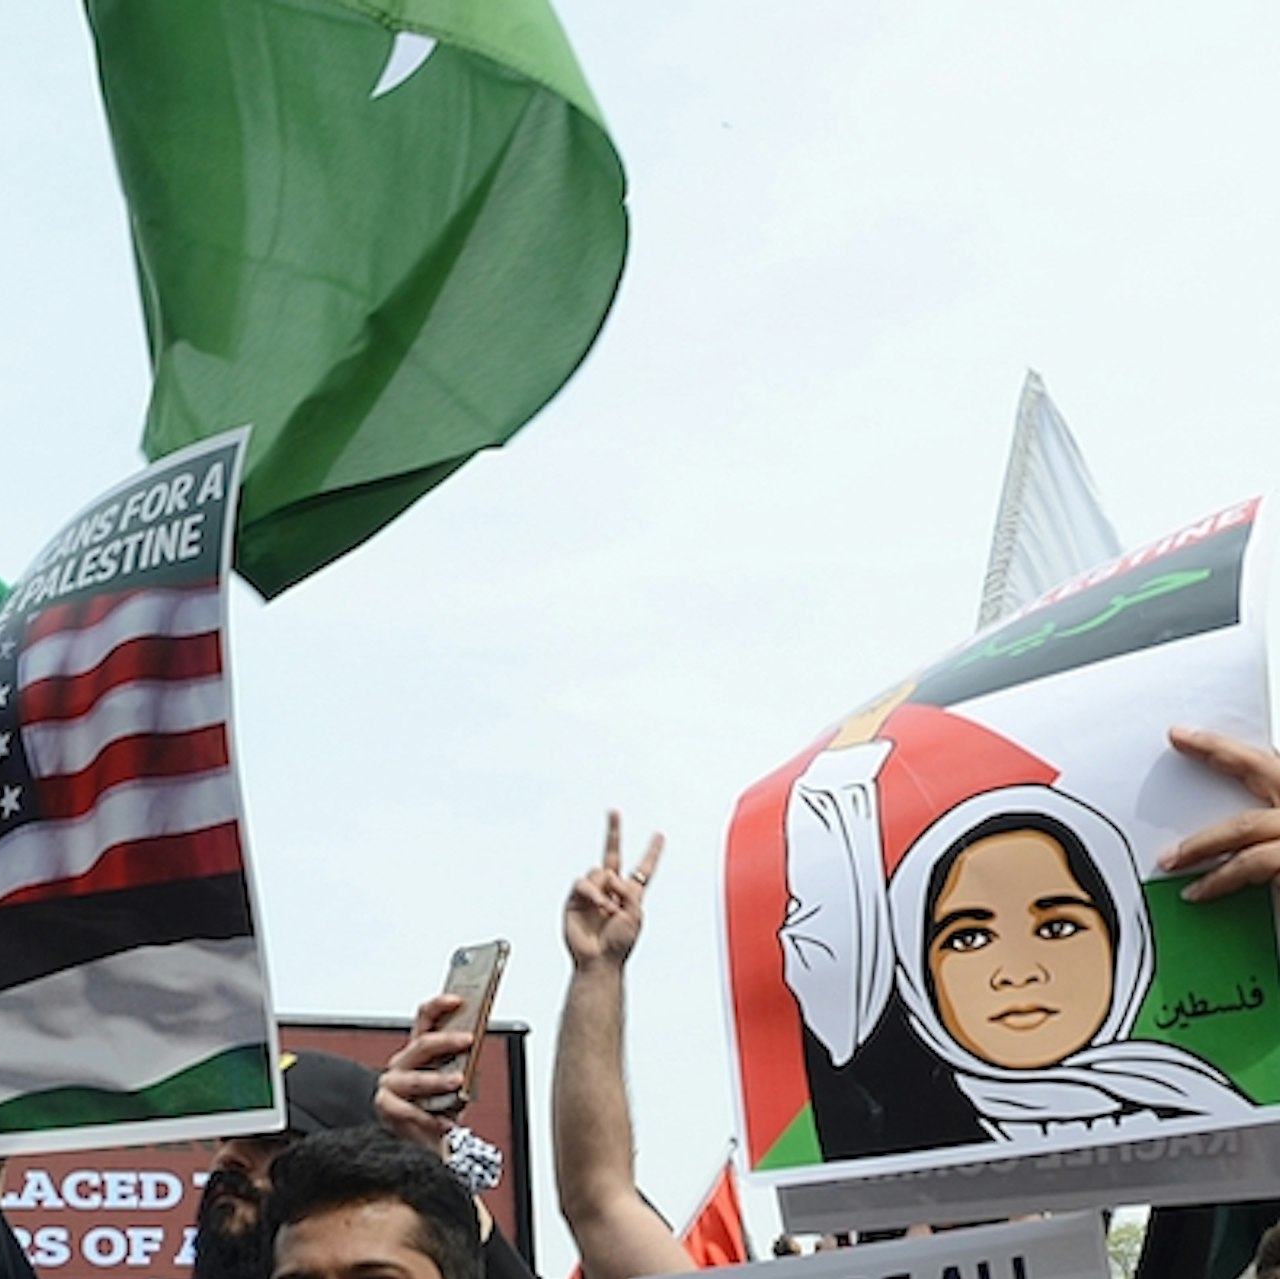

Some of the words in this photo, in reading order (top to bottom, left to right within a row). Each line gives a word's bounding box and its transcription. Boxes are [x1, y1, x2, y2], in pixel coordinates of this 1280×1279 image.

[119, 472, 195, 532] FOR
[196, 462, 224, 504] A
[19, 514, 205, 611] PALESTINE
[1155, 974, 1265, 1029] فلسطين
[82, 1226, 164, 1267] OF
